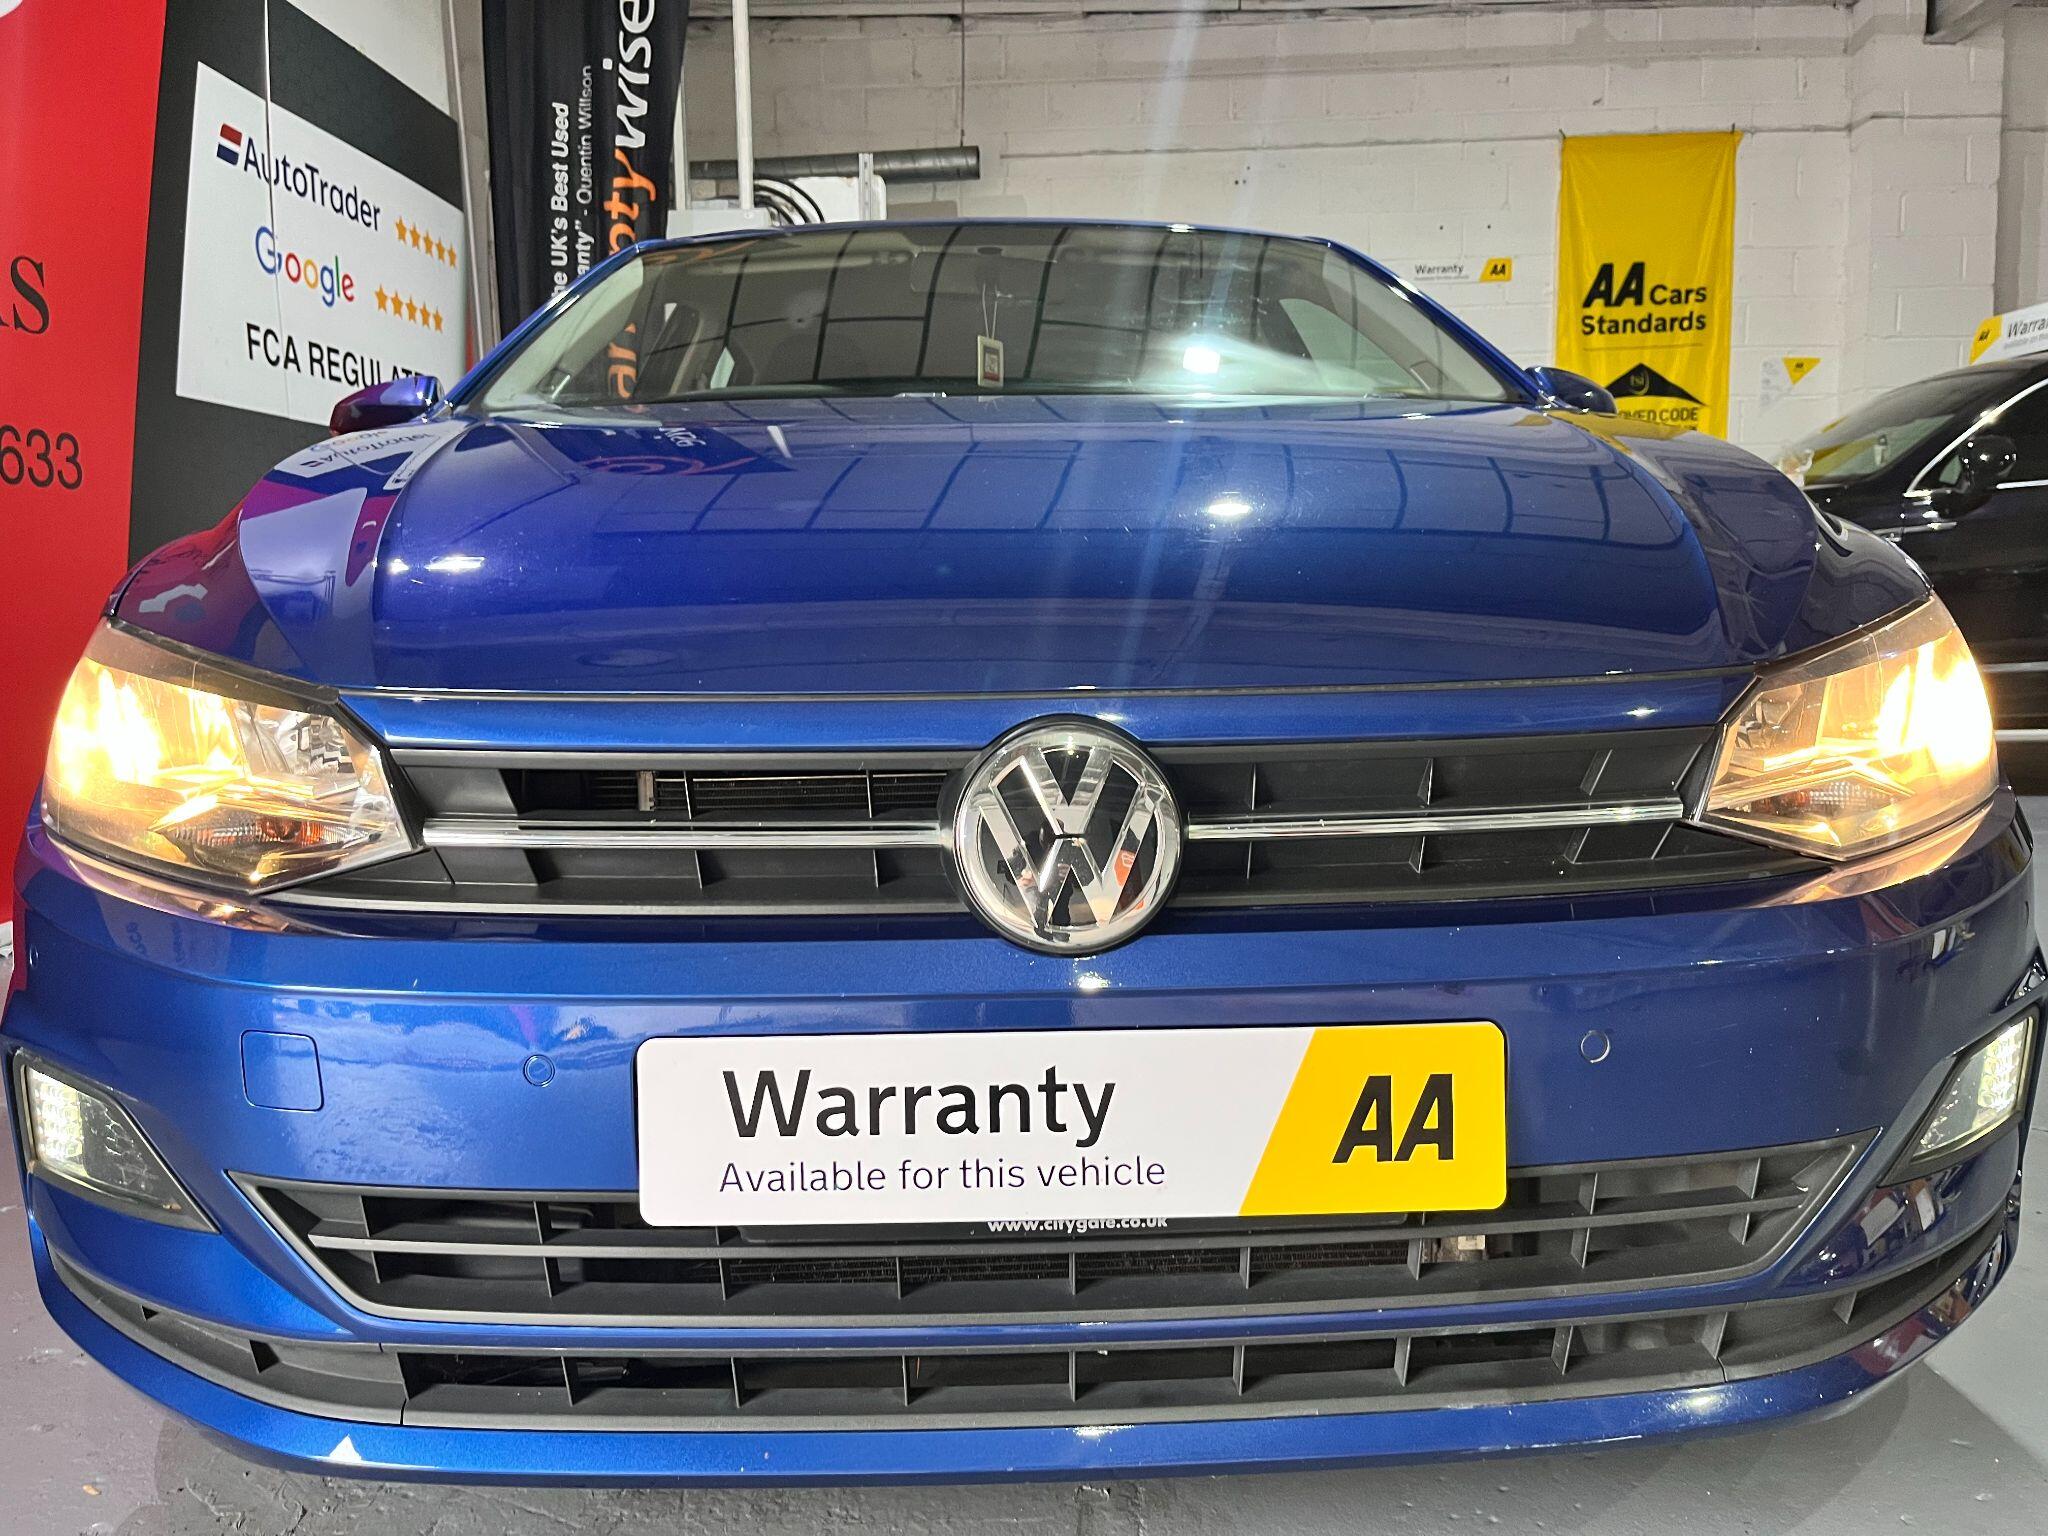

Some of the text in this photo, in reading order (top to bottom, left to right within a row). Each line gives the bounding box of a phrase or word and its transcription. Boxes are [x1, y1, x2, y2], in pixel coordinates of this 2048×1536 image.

[578, 65, 592, 129] Willson
[244, 137, 380, 231] AutoTrader
[576, 135, 592, 204] Quentin
[551, 102, 569, 298] he UK's Best Used
[255, 226, 354, 307] Google
[575, 219, 594, 276] anty”
[1414, 264, 1506, 276] Warranty AA
[1582, 262, 1707, 308] AA Cars
[246, 322, 301, 374] FCA
[1582, 311, 1706, 335] Standards
[1659, 406, 1698, 422] CODE
[0, 424, 83, 490] 633
[722, 1065, 1454, 1163] Warranty AA
[719, 1155, 1165, 1193] Available for this vehicle
